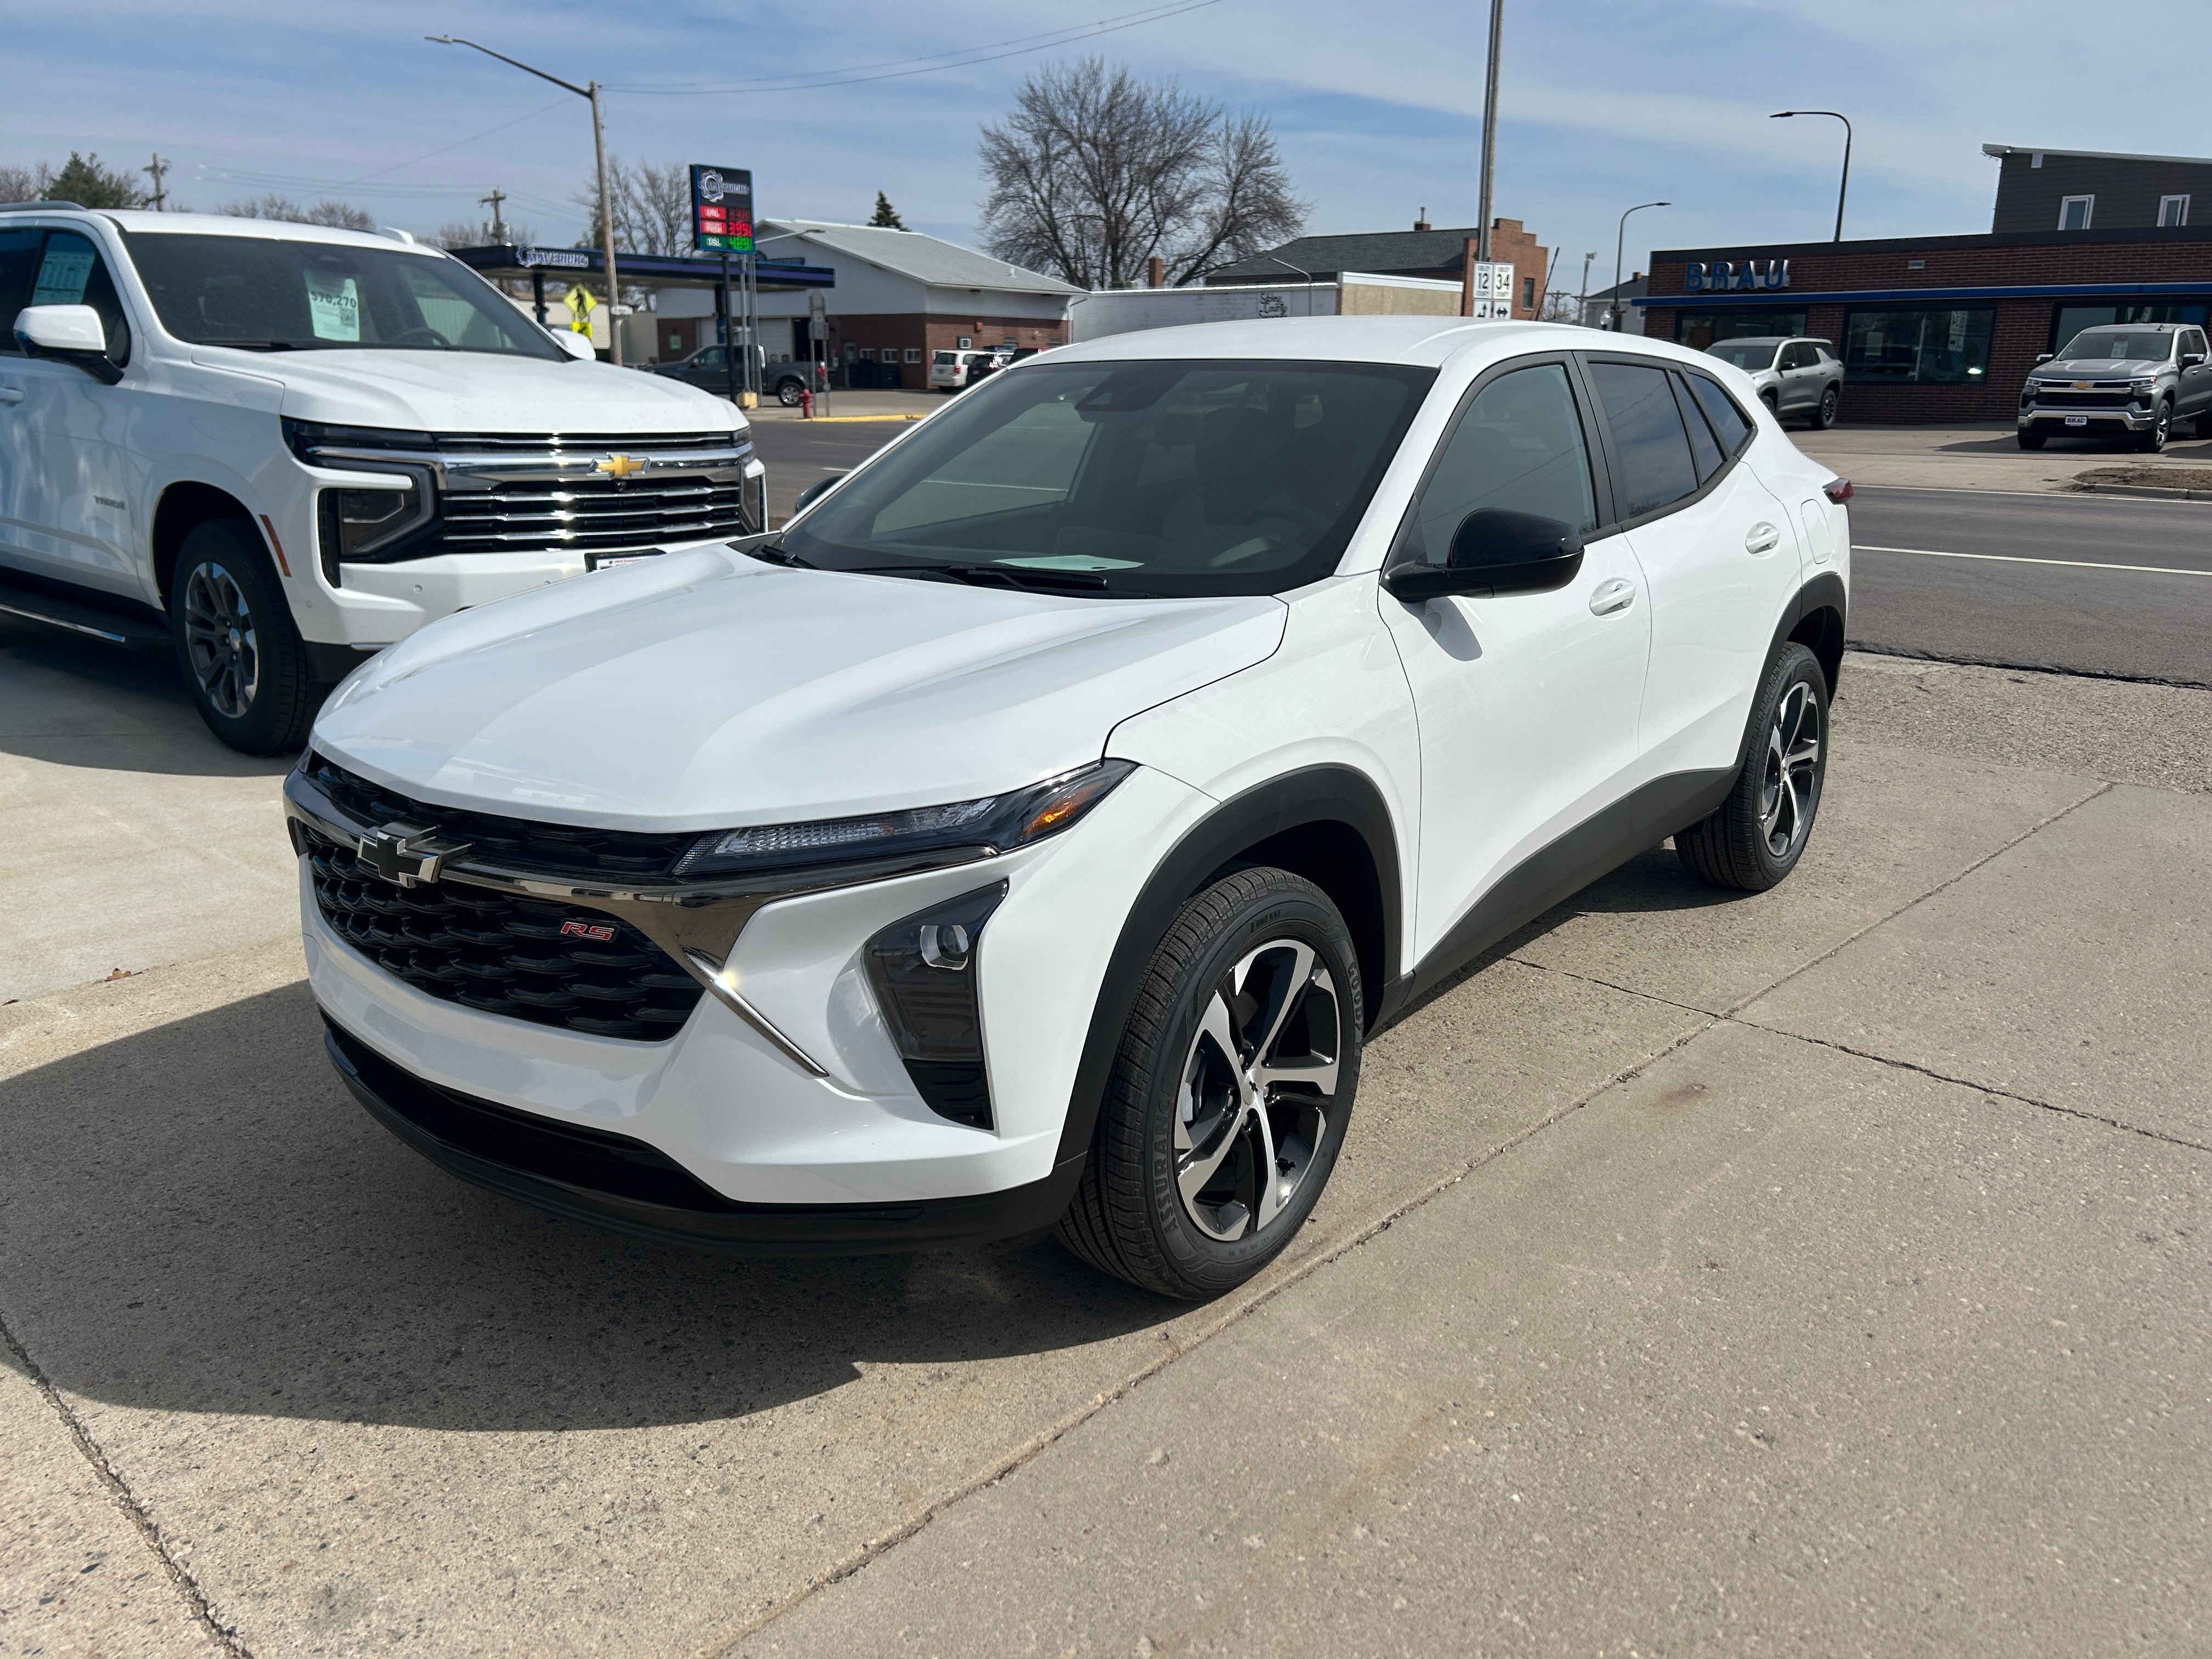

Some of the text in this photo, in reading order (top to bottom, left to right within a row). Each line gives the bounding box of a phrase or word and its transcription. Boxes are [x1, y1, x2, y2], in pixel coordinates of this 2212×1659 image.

[1478, 272, 1489, 290] 12
[1496, 273, 1510, 291] 34
[1685, 259, 1788, 291] BRAU
[560, 921, 615, 941] RS
